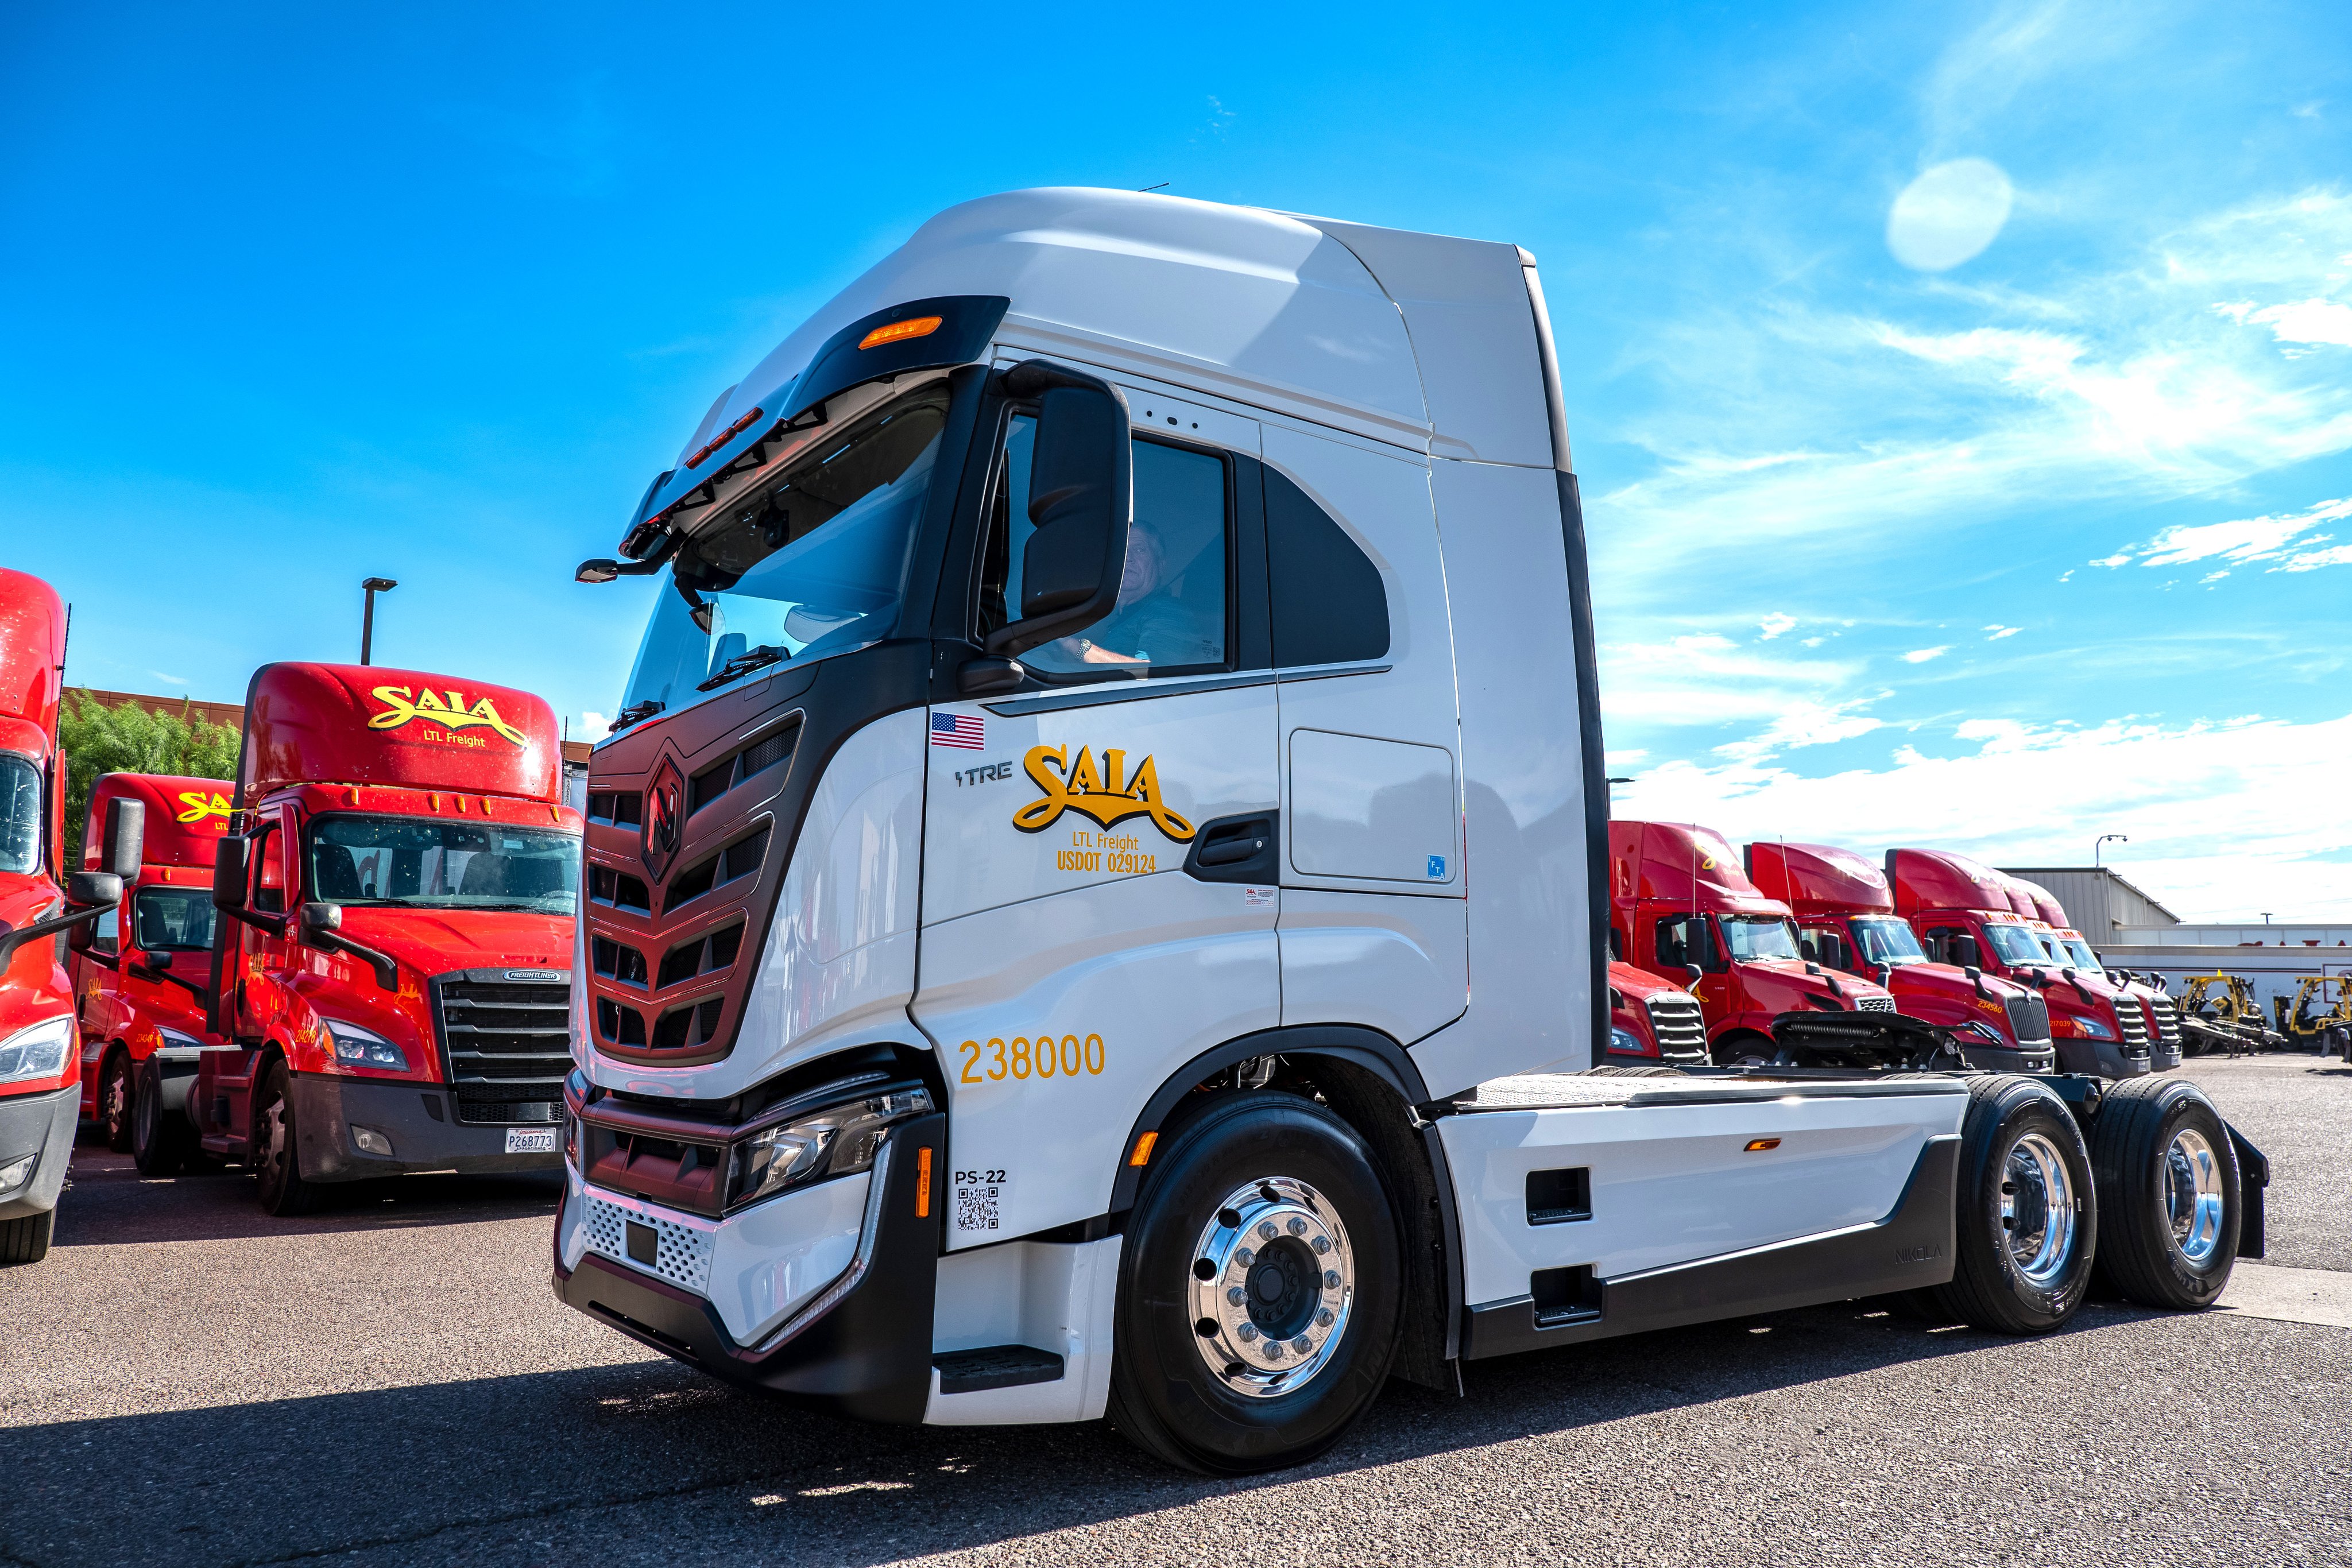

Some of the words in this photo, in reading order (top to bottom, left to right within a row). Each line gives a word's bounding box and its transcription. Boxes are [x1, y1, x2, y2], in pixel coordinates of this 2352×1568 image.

[368, 686, 532, 750] SAIA
[424, 730, 443, 742] LTL
[446, 733, 486, 748] Freight
[965, 761, 1012, 786] TRE
[1012, 743, 1196, 845] SAIA
[176, 792, 234, 824] SA
[215, 822, 229, 831] LTL
[1072, 831, 1093, 847] LTL
[1097, 833, 1139, 853] Freight
[1057, 850, 1102, 872] USDOT
[1108, 854, 1156, 873] 029124
[1977, 1000, 2003, 1014] 234560
[959, 1033, 1105, 1084] 238000
[509, 1136, 552, 1147] P268773
[955, 1170, 1006, 1184] PS-22
